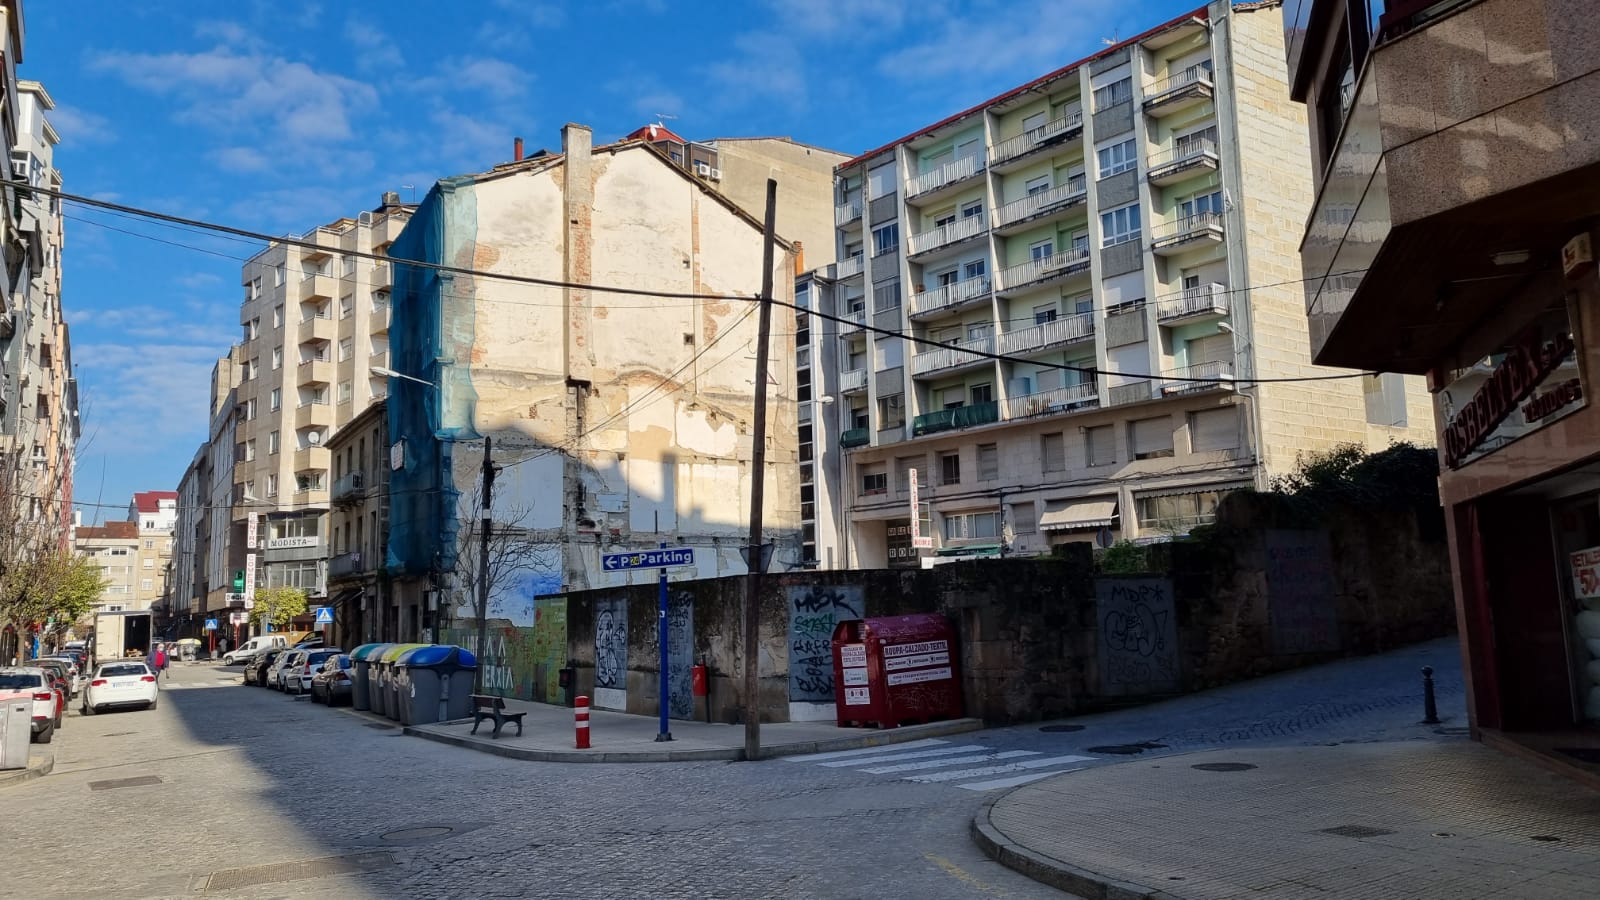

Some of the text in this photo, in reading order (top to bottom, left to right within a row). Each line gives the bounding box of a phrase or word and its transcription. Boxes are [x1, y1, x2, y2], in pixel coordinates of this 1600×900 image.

[248, 514, 257, 547] CENTRO
[271, 538, 306, 548] MODISTA
[621, 557, 629, 567] P
[639, 552, 692, 565] Parking
[246, 556, 255, 608] COMERCIAL
